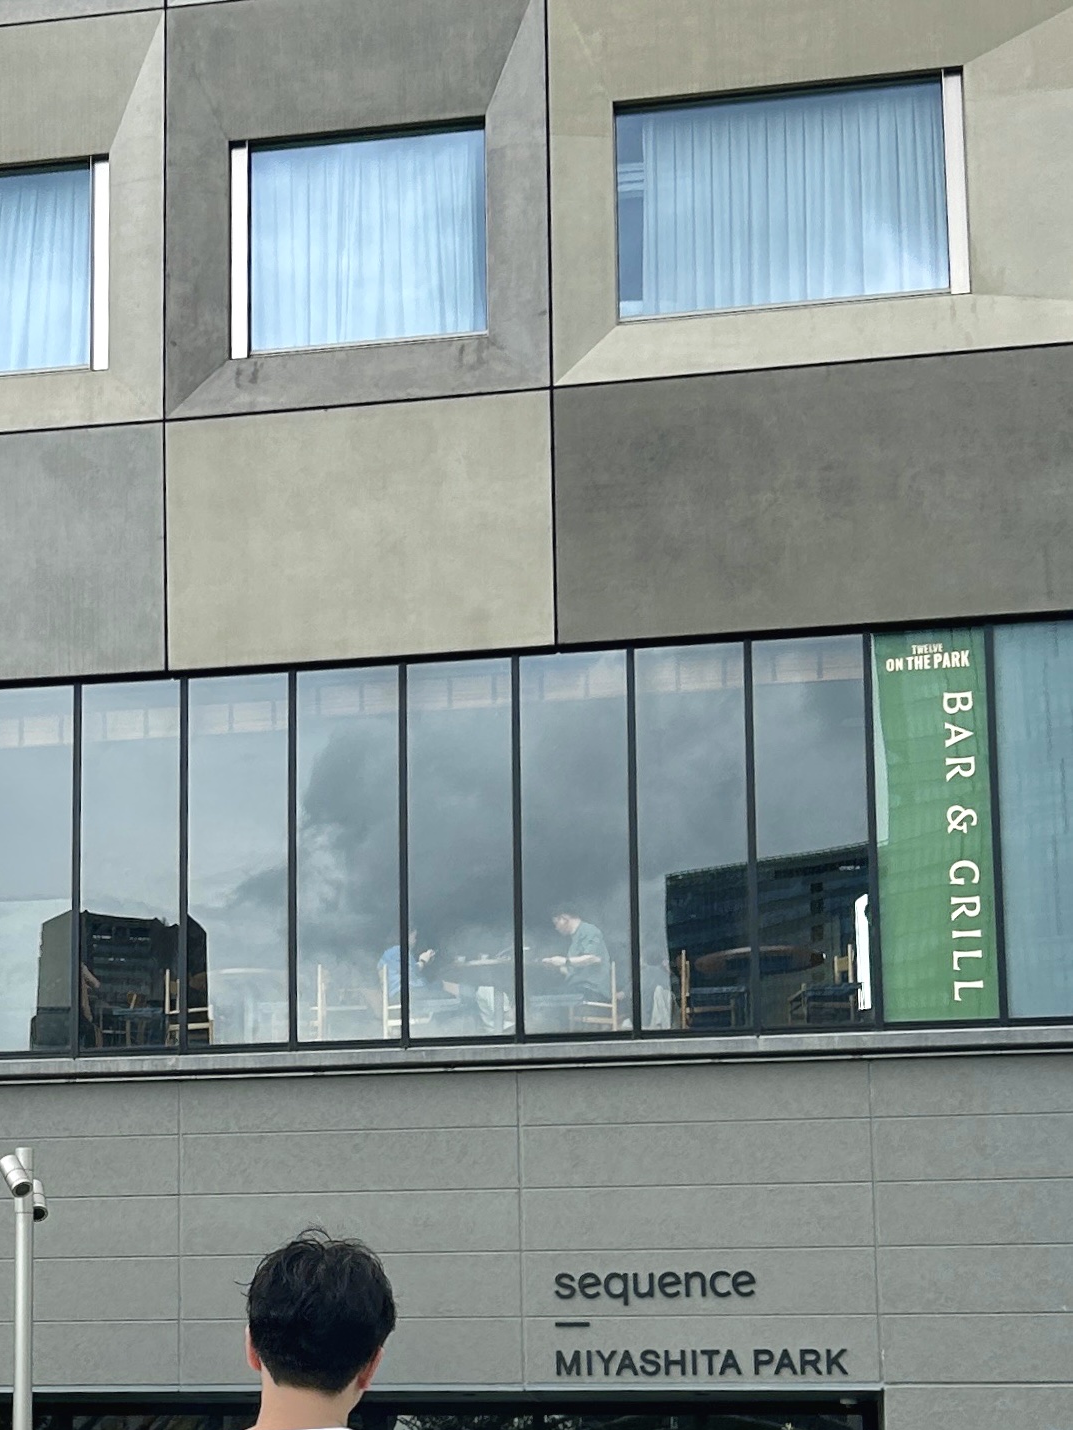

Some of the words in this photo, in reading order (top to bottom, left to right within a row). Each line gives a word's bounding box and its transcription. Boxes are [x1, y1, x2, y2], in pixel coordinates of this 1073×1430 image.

[886, 658, 904, 672] ON
[906, 654, 931, 671] THE
[933, 650, 970, 669] PARK
[911, 643, 943, 655] TWELVE
[942, 690, 975, 782] BAR
[946, 805, 978, 834] &
[949, 860, 984, 1002] GRILL
[555, 1270, 756, 1306] sequence
[556, 1349, 742, 1376] MIYASHITA
[753, 1349, 848, 1376] PARK
